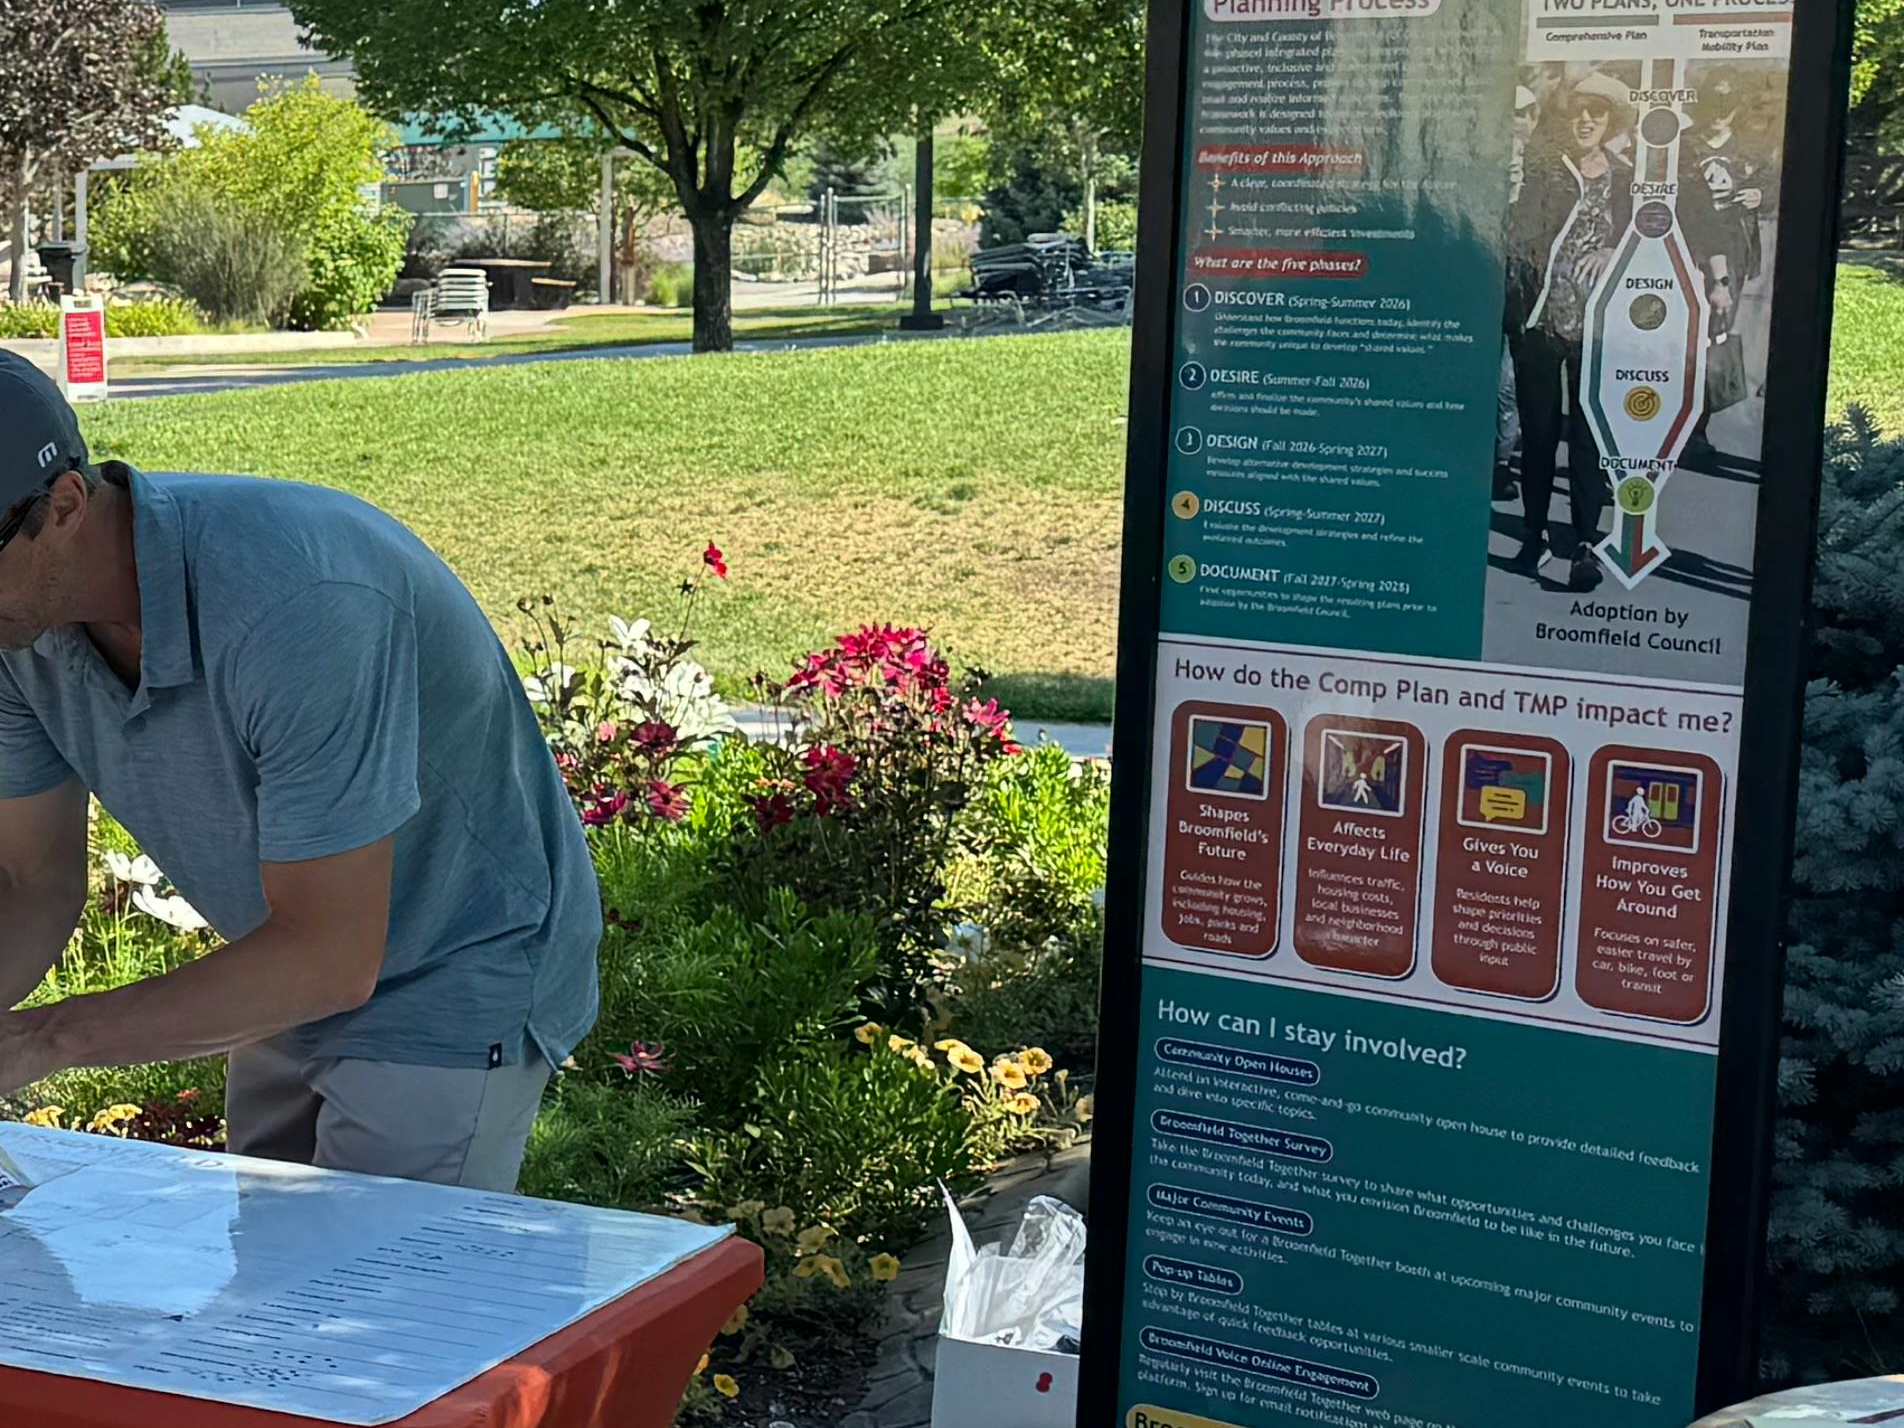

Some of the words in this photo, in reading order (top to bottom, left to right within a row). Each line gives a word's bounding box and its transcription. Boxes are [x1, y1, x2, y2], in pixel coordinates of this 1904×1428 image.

[1545, 30, 1622, 42] Comprehensive
[1625, 30, 1647, 41] Plan
[1699, 27, 1775, 40] Transportation
[1701, 42, 1744, 52] Mobility
[1629, 90, 1695, 102] DISCOVER
[1198, 151, 1250, 164] Benefits
[1254, 151, 1268, 164] of
[1272, 151, 1297, 164] this
[1299, 151, 1362, 165] Approach
[1631, 183, 1676, 195] DESIRE
[1194, 255, 1227, 269] What
[1231, 256, 1253, 270] are
[1257, 257, 1278, 271] the
[1281, 257, 1306, 271] five
[1309, 258, 1360, 272] phases?
[1626, 278, 1673, 290] DESIGN
[1214, 291, 1285, 307] DISCOVER
[1287, 293, 1376, 310] (Spring-Summer
[1379, 295, 1411, 311] 2026)
[1210, 369, 1259, 385] DESIRE
[1262, 371, 1336, 388] (Summer-Fall
[1615, 369, 1669, 383] DISCUSS
[1206, 434, 1257, 451] DESIGN
[1261, 437, 1286, 453] (Fall
[1600, 456, 1674, 472] DOCUMENT
[1203, 499, 1261, 517] DISCUSS
[1263, 503, 1350, 523] (Spring-Summer
[1199, 563, 1280, 584] DOCUMENT
[1569, 599, 1657, 625] Adoption
[1664, 607, 1689, 628] by
[1535, 622, 1641, 649] Broomfield
[1646, 632, 1721, 656] Council
[1174, 658, 1224, 684] How
[1233, 663, 1261, 688] do
[1270, 667, 1310, 693] the
[1318, 672, 1387, 701] Comp
[1396, 679, 1449, 707] Plan
[1458, 685, 1505, 713] and
[1512, 691, 1567, 719] TMP
[1576, 697, 1668, 729] impact
[1677, 707, 1732, 736] me?
[1199, 803, 1250, 824] Shapes
[1178, 820, 1269, 845] Broomfield's
[1332, 820, 1386, 841] Affects
[1198, 841, 1246, 861] Future
[1307, 836, 1375, 860] Everyday
[1379, 845, 1410, 864] Life
[1462, 836, 1505, 856] Gives
[1509, 842, 1538, 860] You
[1471, 858, 1481, 872] a
[1485, 859, 1528, 878] Voice
[1611, 855, 1688, 881] Improves
[1595, 874, 1632, 892] How
[1636, 879, 1666, 897] You
[1670, 883, 1701, 901] Get
[1616, 897, 1677, 919] Around
[1593, 927, 1640, 945] Focuses
[1644, 934, 1659, 947] on
[1596, 943, 1632, 959] easier
[1636, 948, 1672, 965] travel
[1676, 954, 1691, 967] by
[1591, 958, 1614, 973] car,
[1618, 962, 1647, 977] bike,
[1651, 966, 1677, 982] foot
[1680, 971, 1693, 984] or
[1621, 978, 1662, 994] transit
[1157, 999, 1210, 1029] How
[1217, 1009, 1259, 1038] can
[1270, 1017, 1275, 1040] I
[1284, 1020, 1336, 1050] stay
[1345, 1030, 1466, 1072] involved?
[1163, 1042, 1231, 1067] Community
[1234, 1054, 1266, 1073] Open
[1269, 1060, 1313, 1081] Houses
[1159, 1115, 1224, 1139] Broomfield
[1227, 1127, 1281, 1149] Together
[1284, 1138, 1326, 1158] Survey
[1155, 1188, 1188, 1207] Major
[1192, 1196, 1261, 1222] Community
[1263, 1210, 1304, 1230] Events
[1196, 1269, 1233, 1289] Tables
[1148, 1331, 1212, 1357] Broomfield
[1215, 1346, 1247, 1365] Voice
[1251, 1354, 1291, 1375] Online
[1294, 1364, 1369, 1393] Engagement
